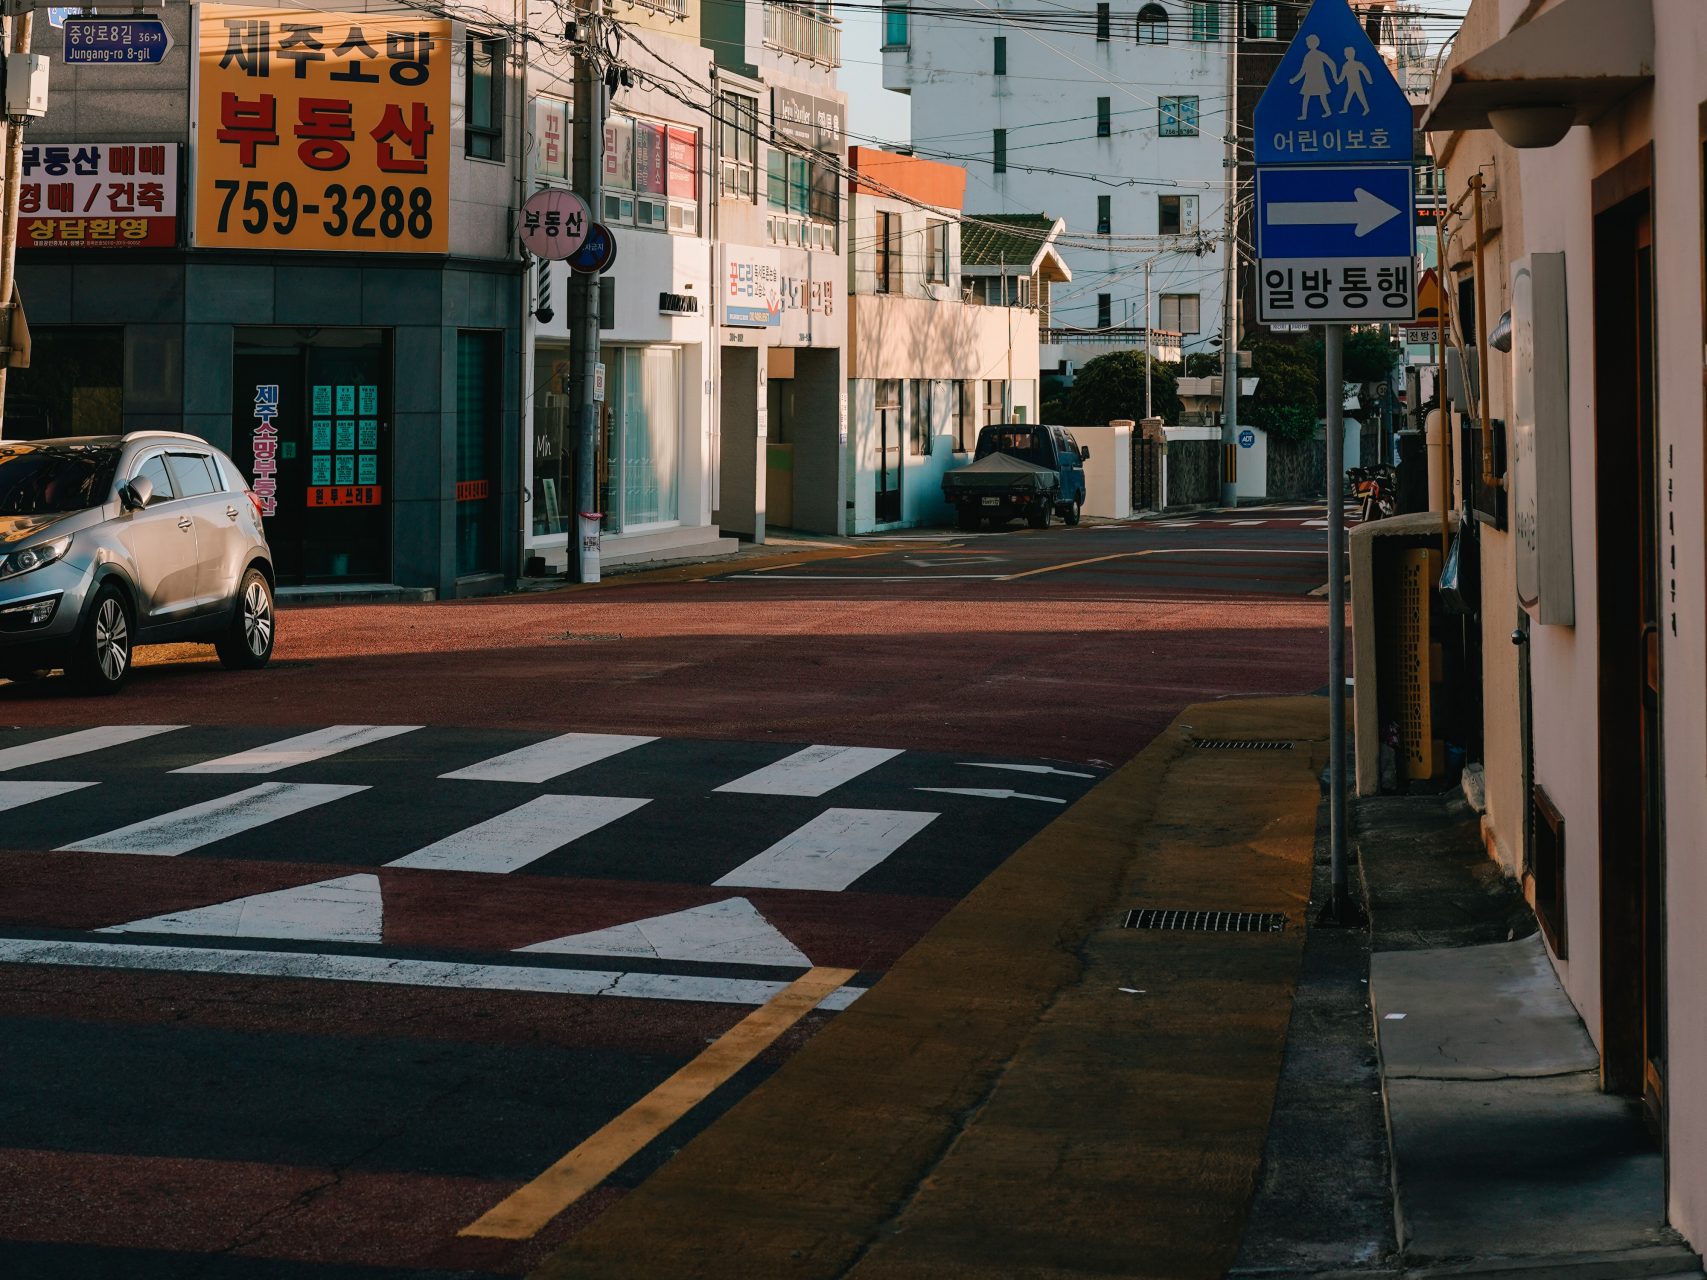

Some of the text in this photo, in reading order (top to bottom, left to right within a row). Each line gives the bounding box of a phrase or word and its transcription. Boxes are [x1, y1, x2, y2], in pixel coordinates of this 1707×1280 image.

[69, 25, 132, 45] 중앙로8길
[69, 47, 150, 62] Jungang-ro 8-gil
[218, 19, 435, 87] 제주소망
[216, 91, 434, 174] 부동산
[1273, 128, 1391, 153] 어린이보호
[22, 145, 166, 176] 부동산 매매
[18, 182, 74, 213] 경매
[106, 182, 165, 213] 건축
[214, 179, 433, 240] 759-3288
[27, 218, 148, 240] 상담환영
[524, 210, 583, 238] 부동산
[729, 262, 753, 297] 꿈드림
[1265, 266, 1409, 310] 일방통행
[1409, 331, 1429, 342] 전방
[1242, 435, 1253, 443] ADT
